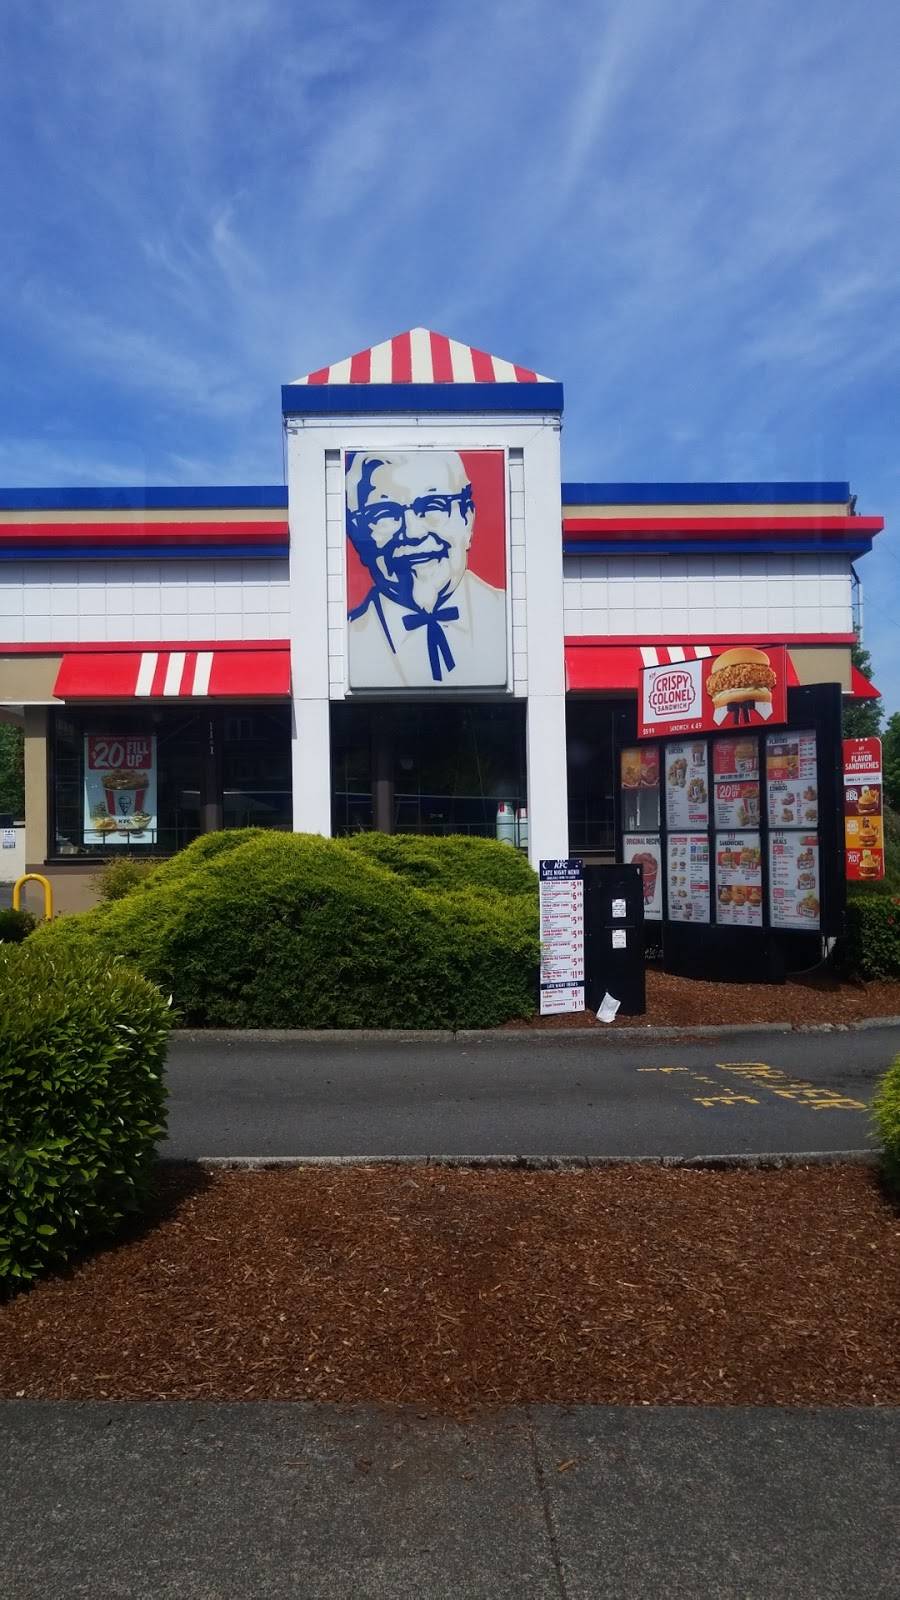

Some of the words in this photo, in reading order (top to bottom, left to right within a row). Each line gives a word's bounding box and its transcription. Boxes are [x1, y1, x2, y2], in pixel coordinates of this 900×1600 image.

[656, 675, 689, 692] CRISPY
[652, 689, 692, 705] COLONEL
[657, 702, 687, 712] SANDWICH
[127, 741, 149, 754] FILL
[127, 754, 143, 767] UP
[851, 754, 873, 763] FLAVOR
[844, 761, 880, 771] SANDWICHES
[625, 837, 646, 846] ORIGINAL
[553, 861, 568, 869] KFC
